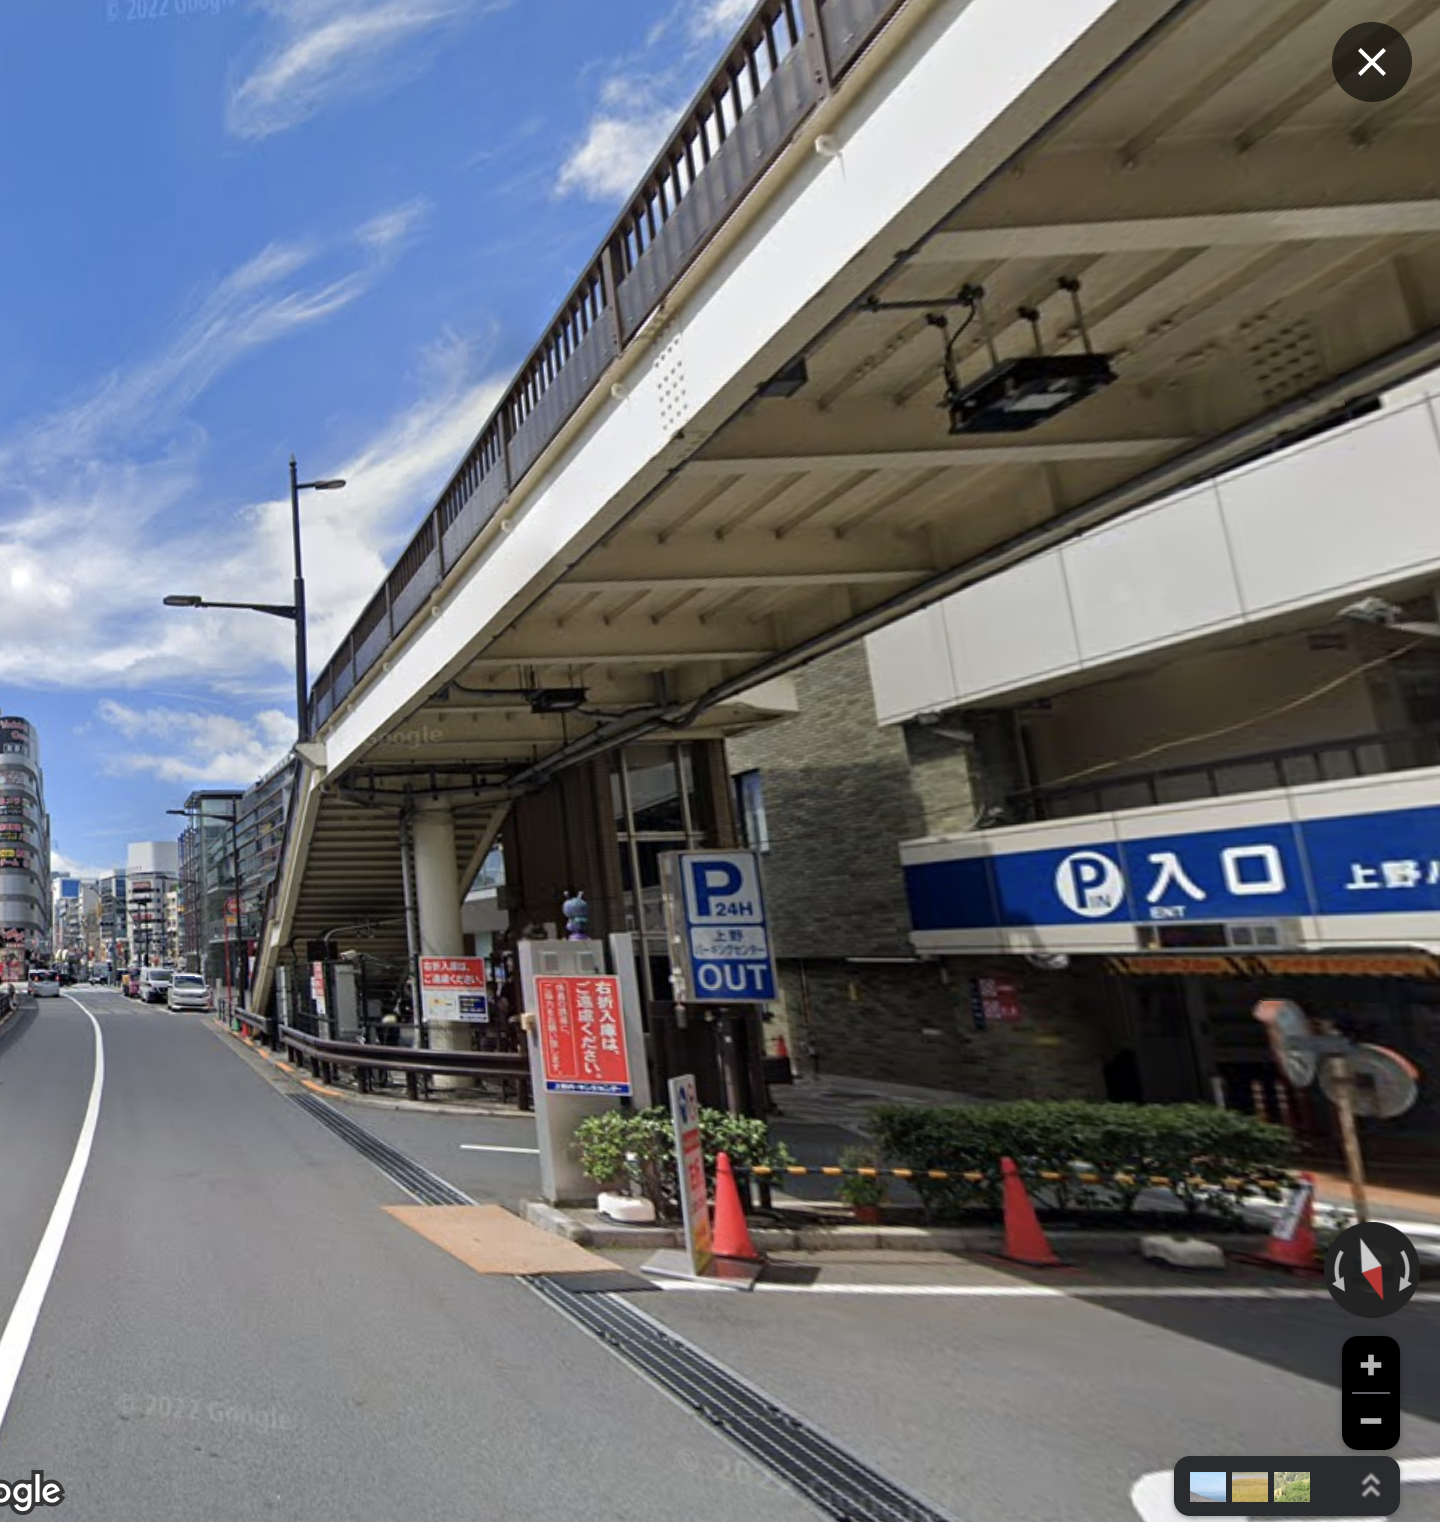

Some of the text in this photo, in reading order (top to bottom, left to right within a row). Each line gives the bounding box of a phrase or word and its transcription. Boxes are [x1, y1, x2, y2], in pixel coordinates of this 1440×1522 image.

[1146, 843, 1287, 904] 入口
[690, 860, 744, 918] P
[715, 900, 754, 917] 24H
[1148, 904, 1187, 919] ENT
[713, 929, 744, 943] 上野
[698, 962, 768, 992] OUT
